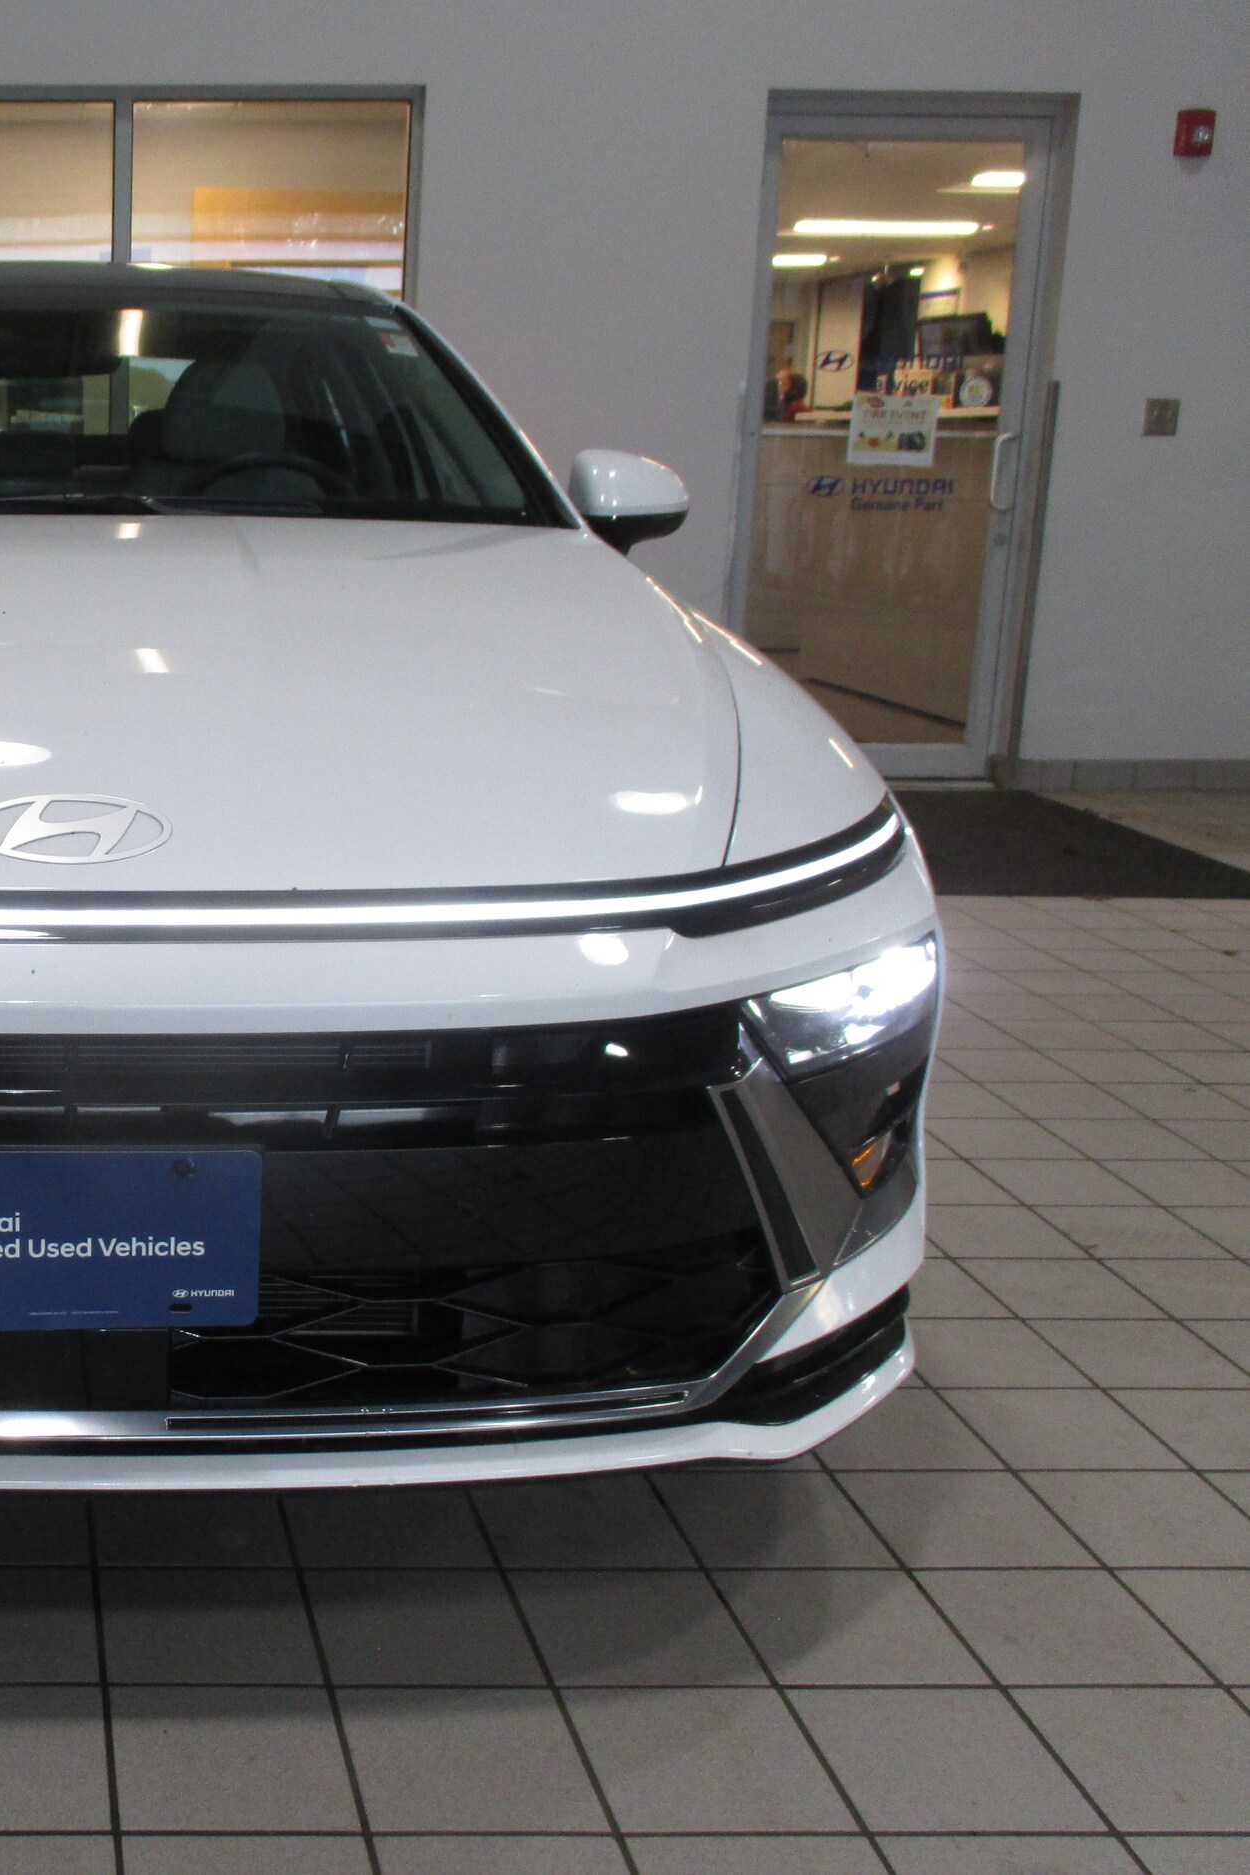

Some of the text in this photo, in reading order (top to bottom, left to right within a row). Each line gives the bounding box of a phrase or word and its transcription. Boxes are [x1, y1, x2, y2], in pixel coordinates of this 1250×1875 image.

[852, 477, 955, 494] HYUNDAI
[28, 1237, 92, 1258] Used
[98, 1236, 205, 1257] Vehicles
[190, 1289, 235, 1297] HYUNDAI
